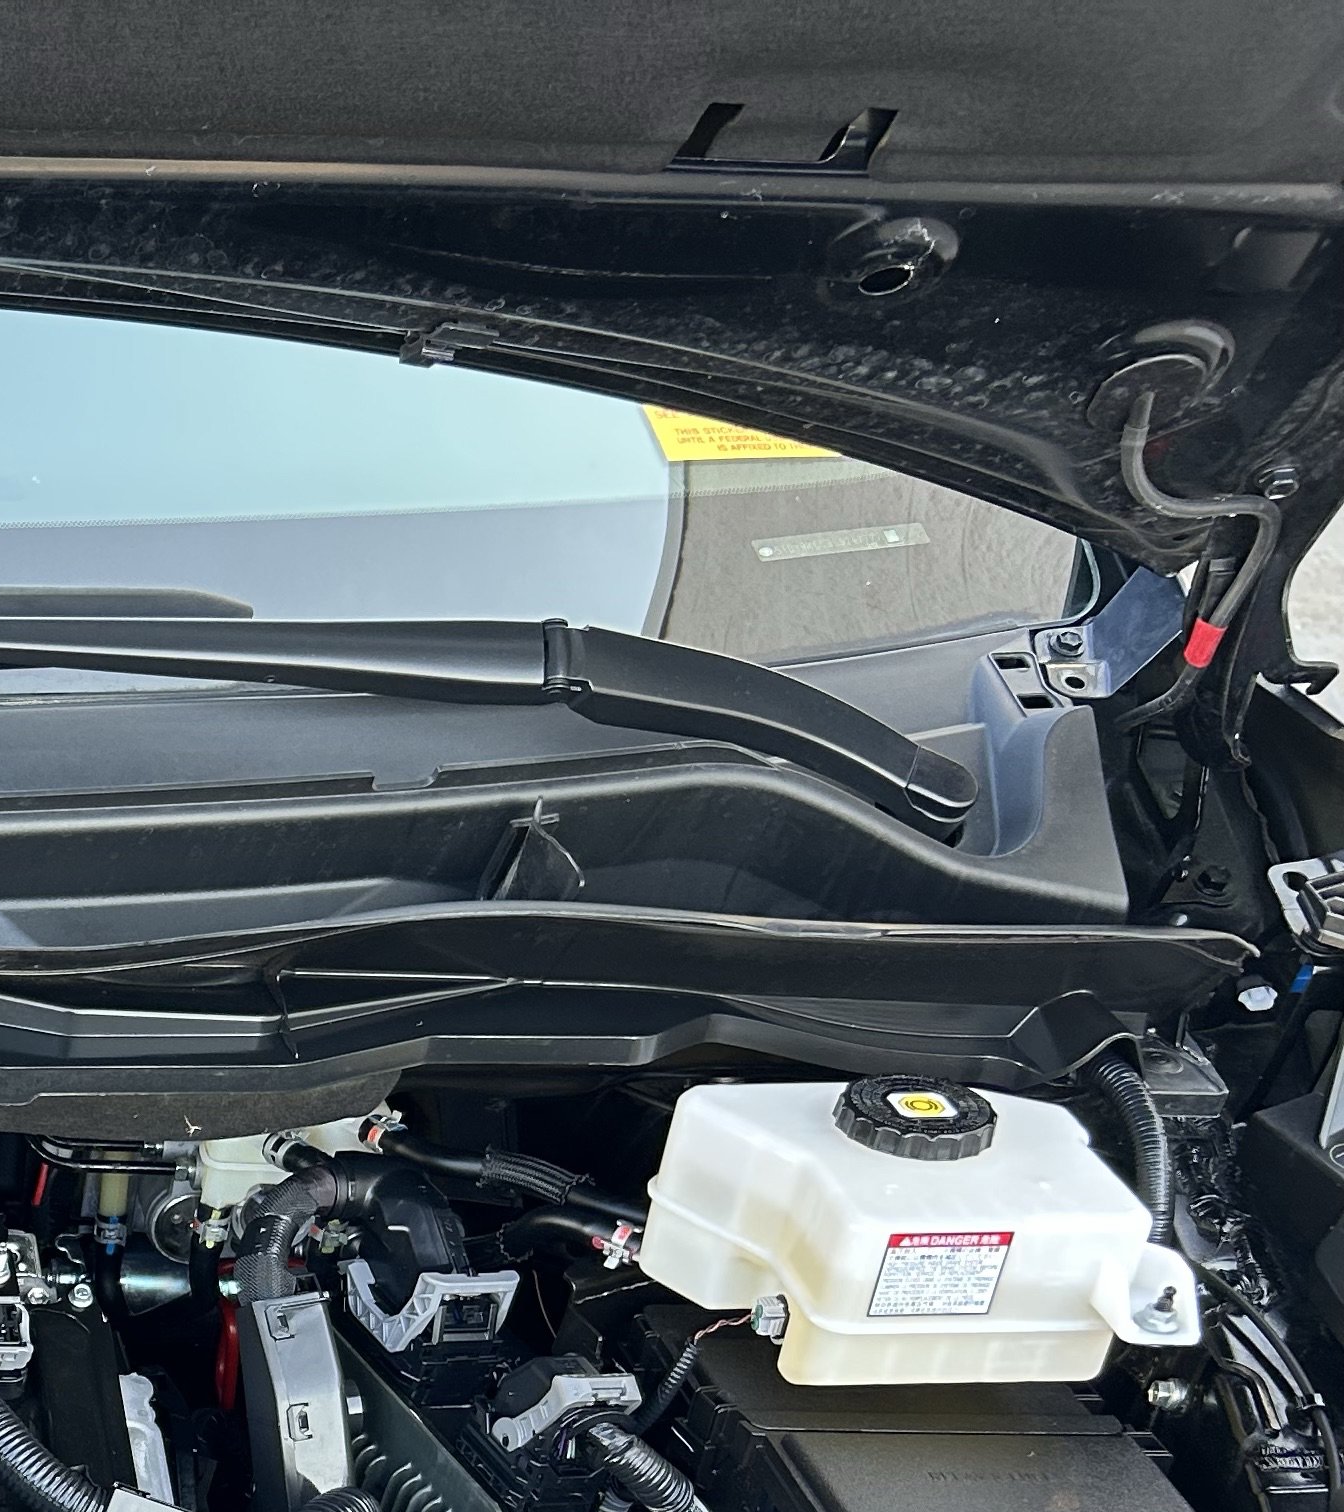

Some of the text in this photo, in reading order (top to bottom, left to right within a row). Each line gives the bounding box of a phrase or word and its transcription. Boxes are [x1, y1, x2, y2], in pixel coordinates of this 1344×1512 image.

[708, 435, 716, 443] A
[718, 434, 762, 443] FEDERAL
[930, 1234, 980, 1247] DANGER
